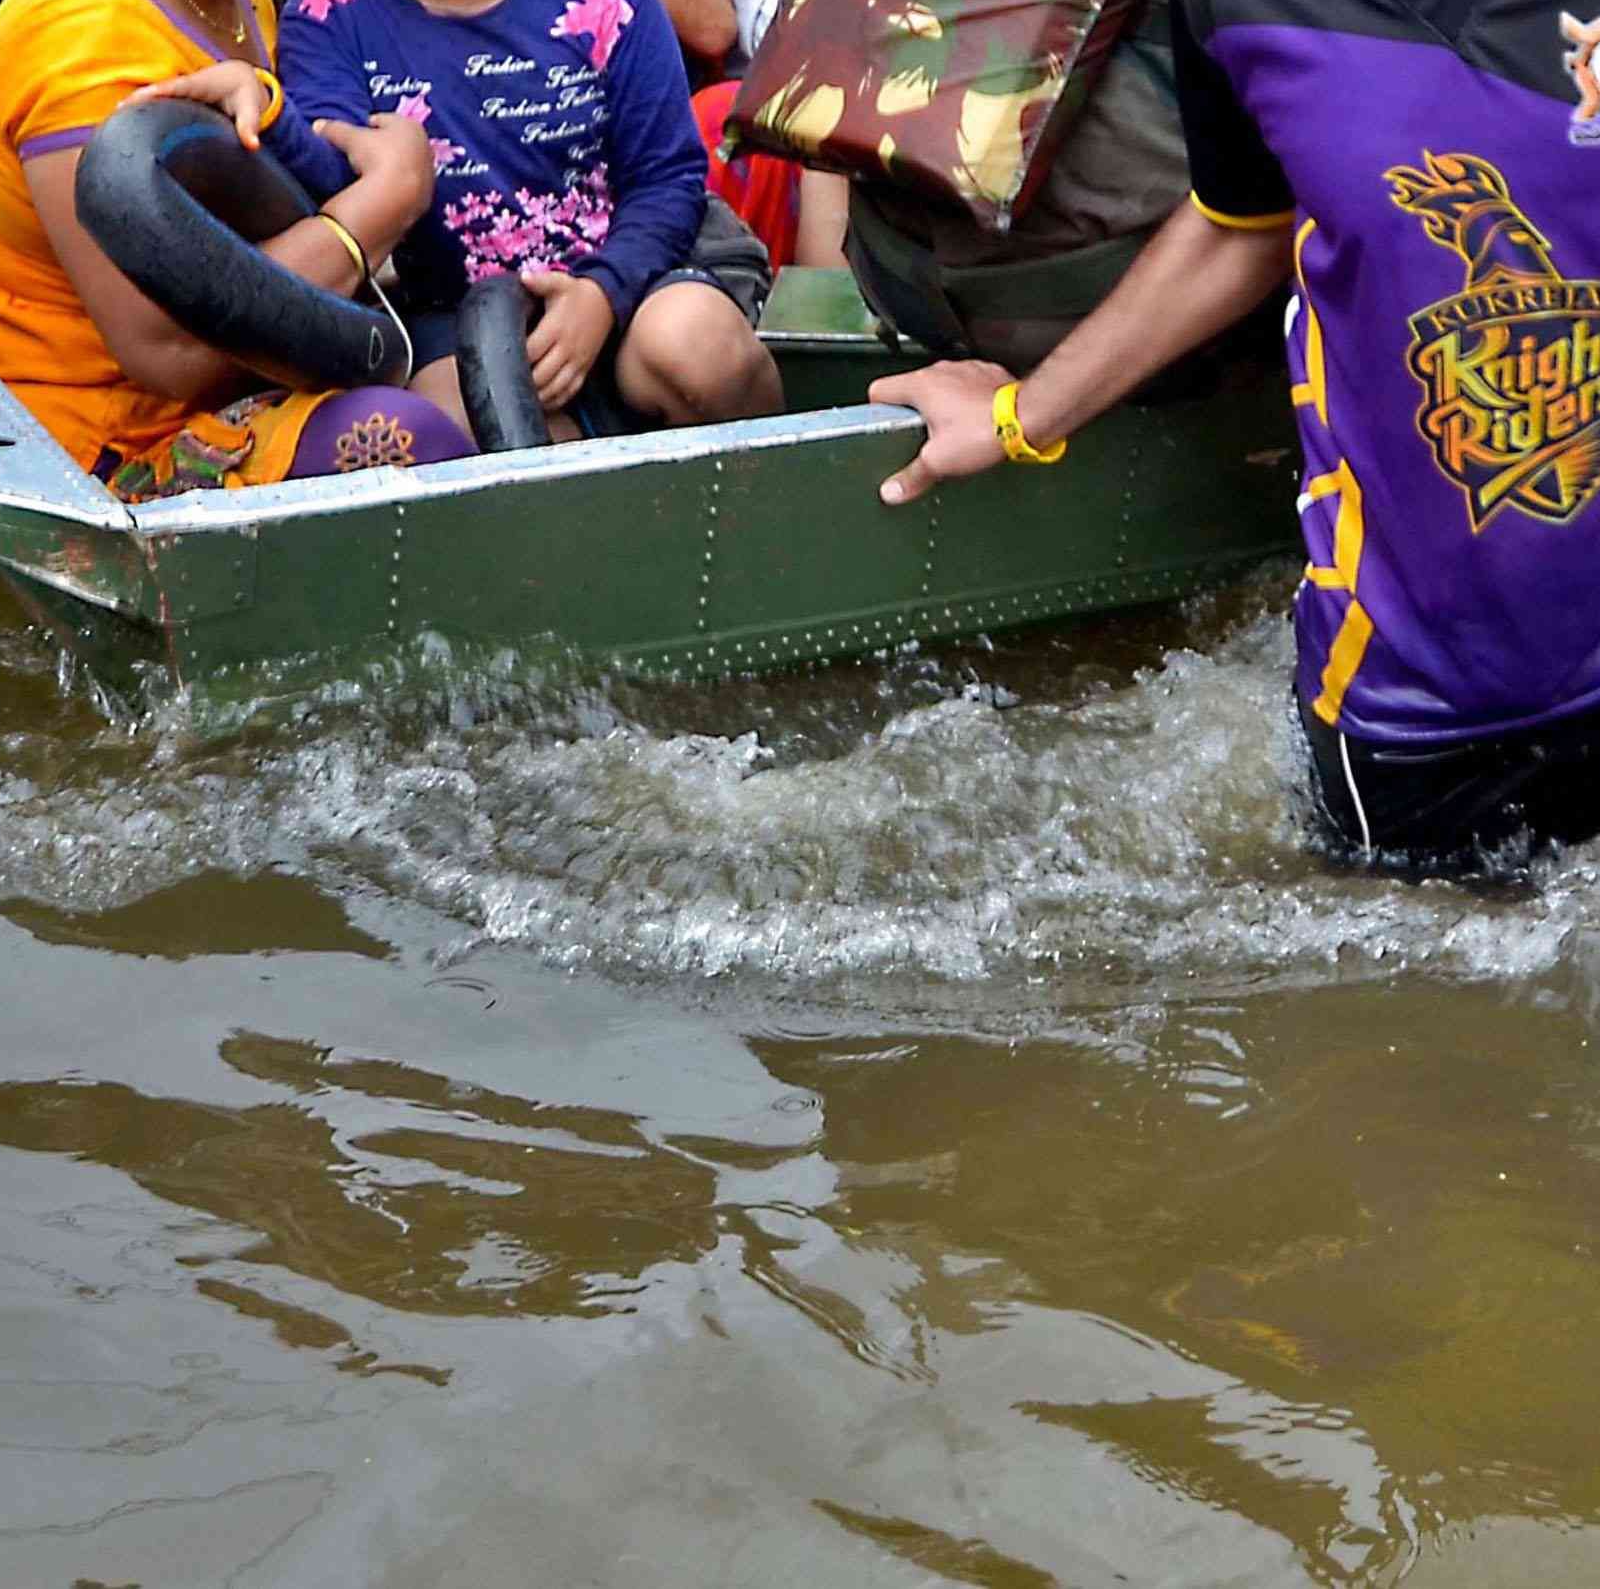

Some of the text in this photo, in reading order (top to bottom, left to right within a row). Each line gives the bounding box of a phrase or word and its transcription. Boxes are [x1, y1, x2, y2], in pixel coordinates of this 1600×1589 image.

[465, 53, 536, 77] Fashion
[480, 97, 550, 119] Fashion
[521, 121, 586, 144] Fashion
